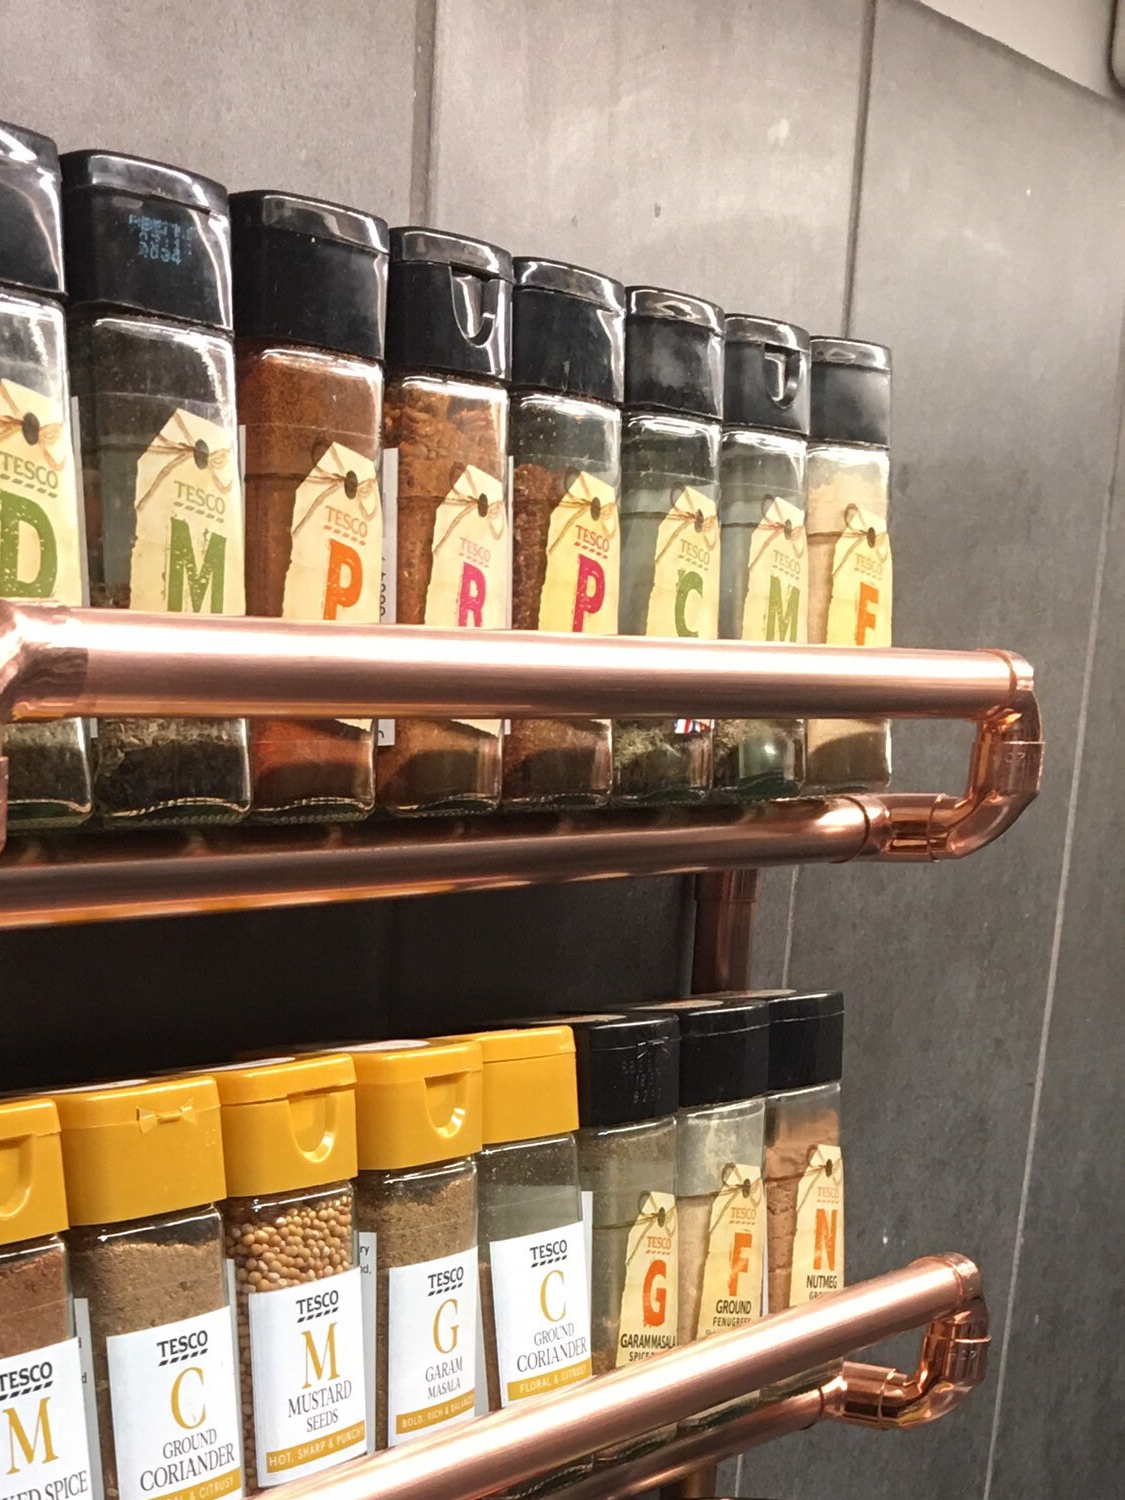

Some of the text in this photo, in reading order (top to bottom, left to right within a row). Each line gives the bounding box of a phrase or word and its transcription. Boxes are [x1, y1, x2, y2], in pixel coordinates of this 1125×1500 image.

[173, 480, 226, 515] TESCO
[324, 505, 369, 538] TESCO
[575, 524, 610, 552] TESCO
[166, 514, 227, 614] M
[460, 537, 491, 563] TESCO
[680, 538, 711, 565] TESCO
[773, 549, 801, 575] TESCO
[855, 553, 883, 575] TESCO
[322, 537, 363, 620] P
[456, 562, 487, 627] R
[573, 553, 606, 633] P
[674, 568, 703, 638] C
[765, 574, 801, 642] M
[855, 581, 879, 646] F
[817, 1186, 839, 1199] TESCO
[730, 1206, 757, 1220] TESCO
[529, 1239, 567, 1260] TESCO
[646, 1235, 671, 1250] TESCO
[813, 1208, 838, 1271] N
[427, 1266, 464, 1289] TESCO
[728, 1232, 753, 1297] F
[540, 1269, 566, 1322] C
[642, 1259, 667, 1328] G
[806, 1274, 838, 1289] NUTMEG
[295, 1290, 339, 1315] TESCO
[715, 1299, 752, 1315] GROUND
[433, 1298, 459, 1354] G
[533, 1322, 574, 1346] GROUND
[157, 1329, 209, 1357] TESCO
[301, 1322, 340, 1389] M
[516, 1336, 587, 1373] CORIANDER
[425, 1356, 463, 1383] GARAM
[519, 1376, 551, 1394] FLORAL
[171, 1366, 207, 1430] C
[288, 1379, 353, 1418] MUSTARD
[427, 1377, 461, 1400] MASALA
[2, 1396, 59, 1475] M
[306, 1408, 339, 1433] SEEDS
[162, 1427, 217, 1460] GROUND
[298, 1441, 326, 1460] SHARP
[140, 1442, 235, 1492] CORIANDER
